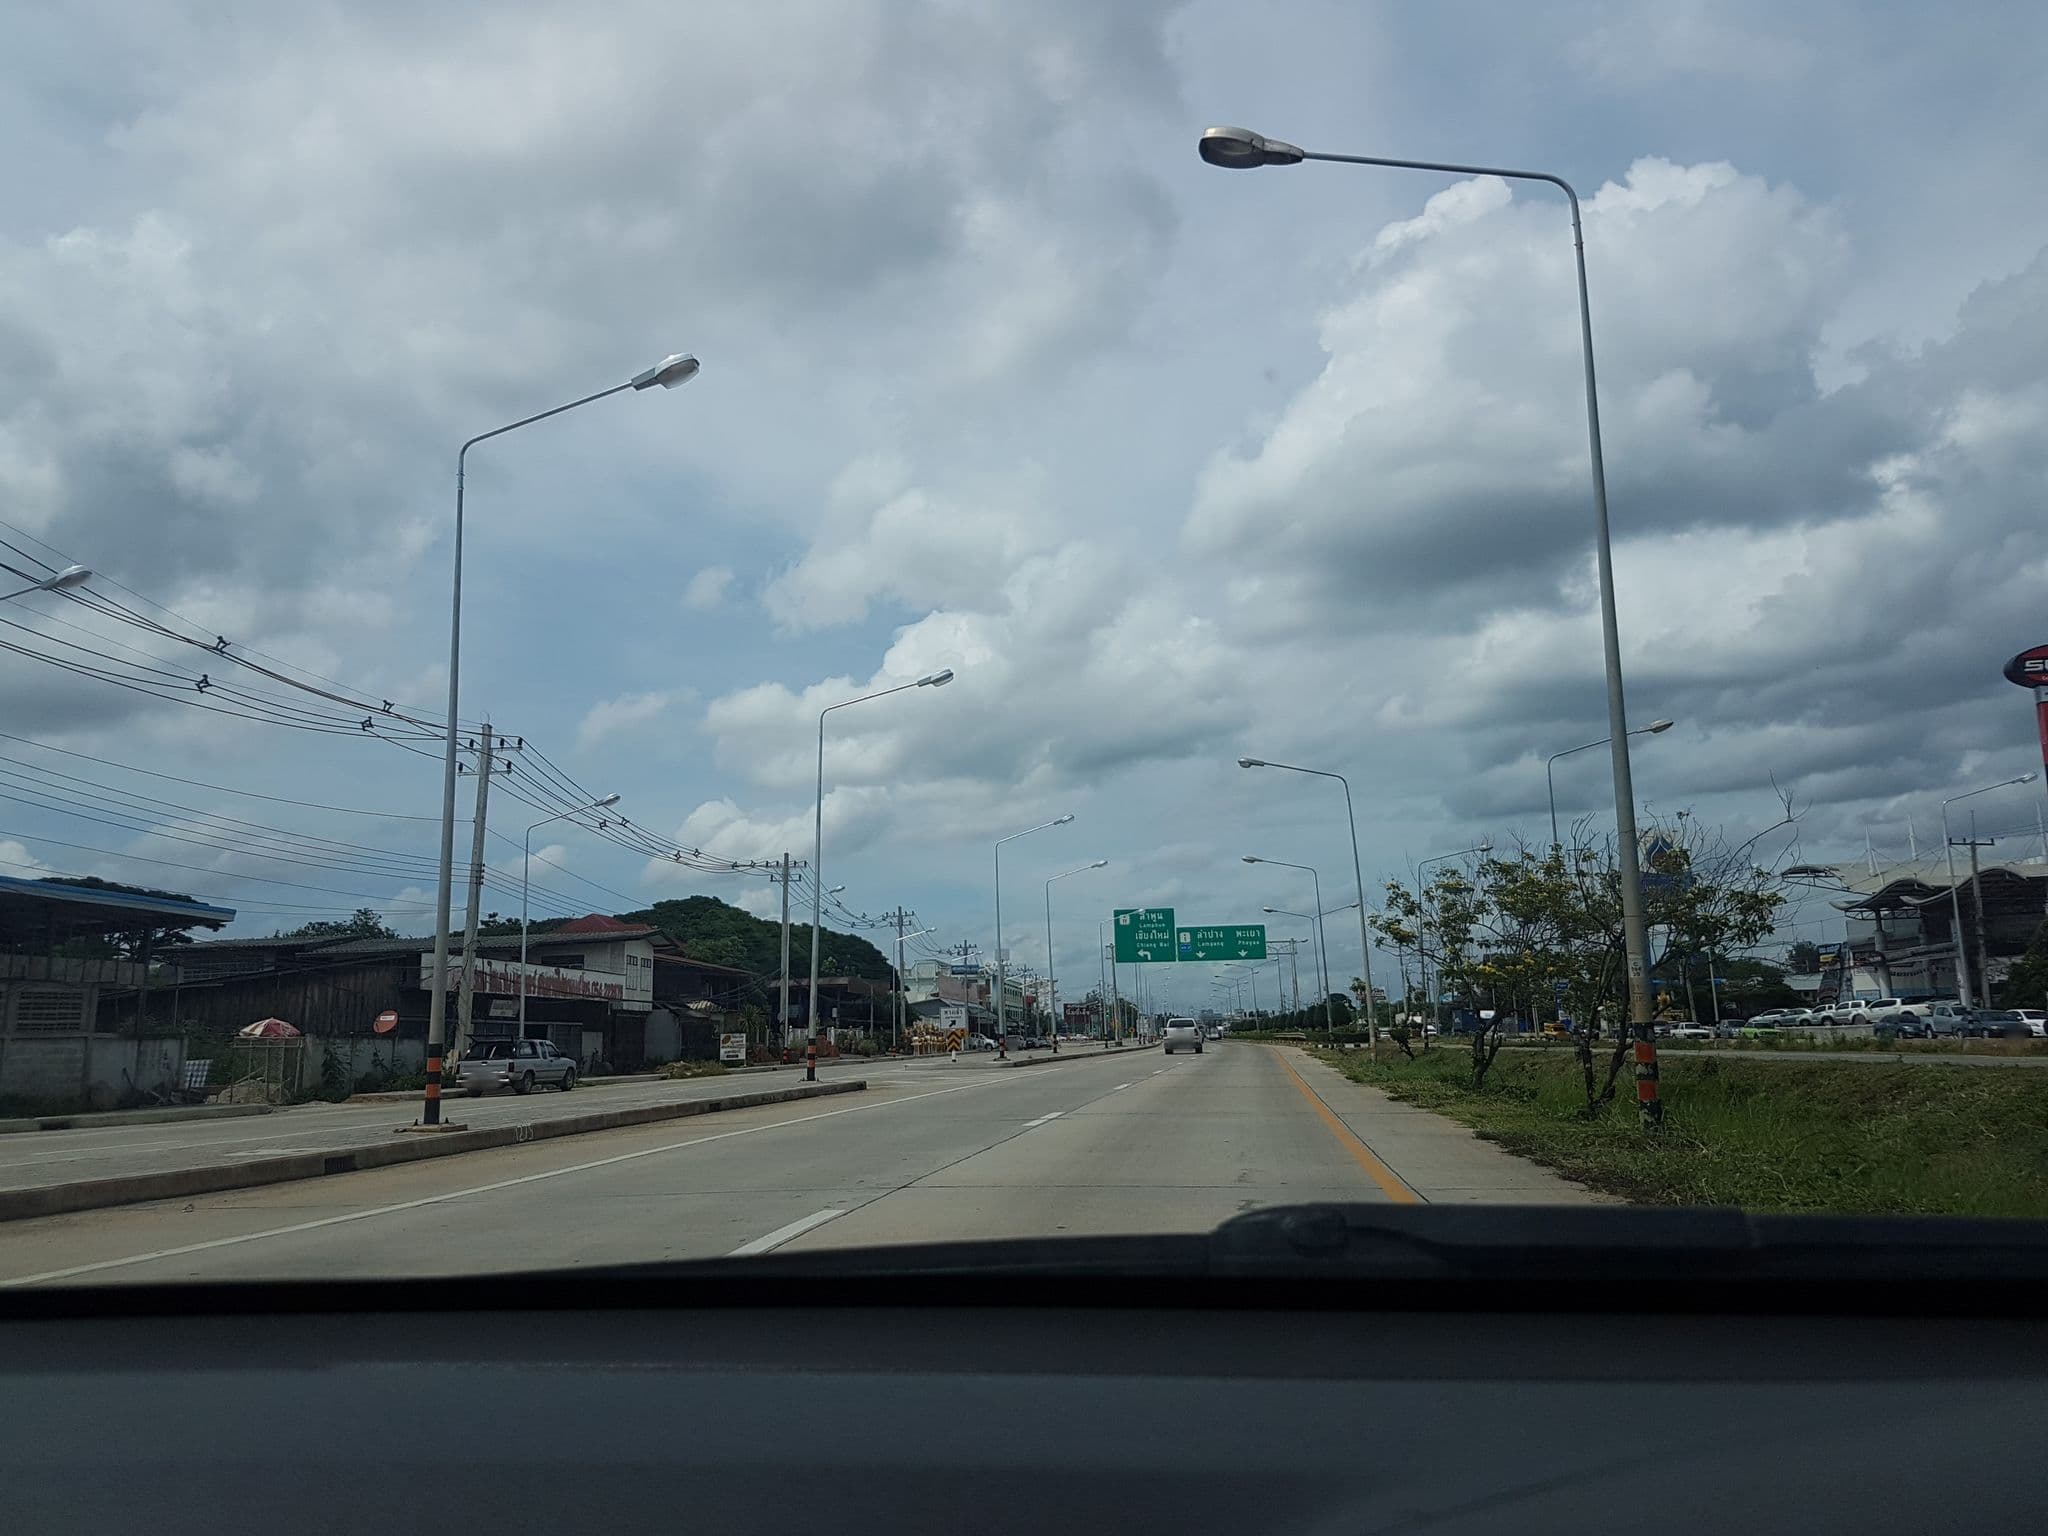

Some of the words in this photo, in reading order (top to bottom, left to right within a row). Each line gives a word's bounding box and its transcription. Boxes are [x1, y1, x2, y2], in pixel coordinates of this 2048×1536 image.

[1136, 929, 1169, 940] เชียงใหม่
[1197, 929, 1223, 939] ลำปาง
[1235, 930, 1260, 938] พะเยา
